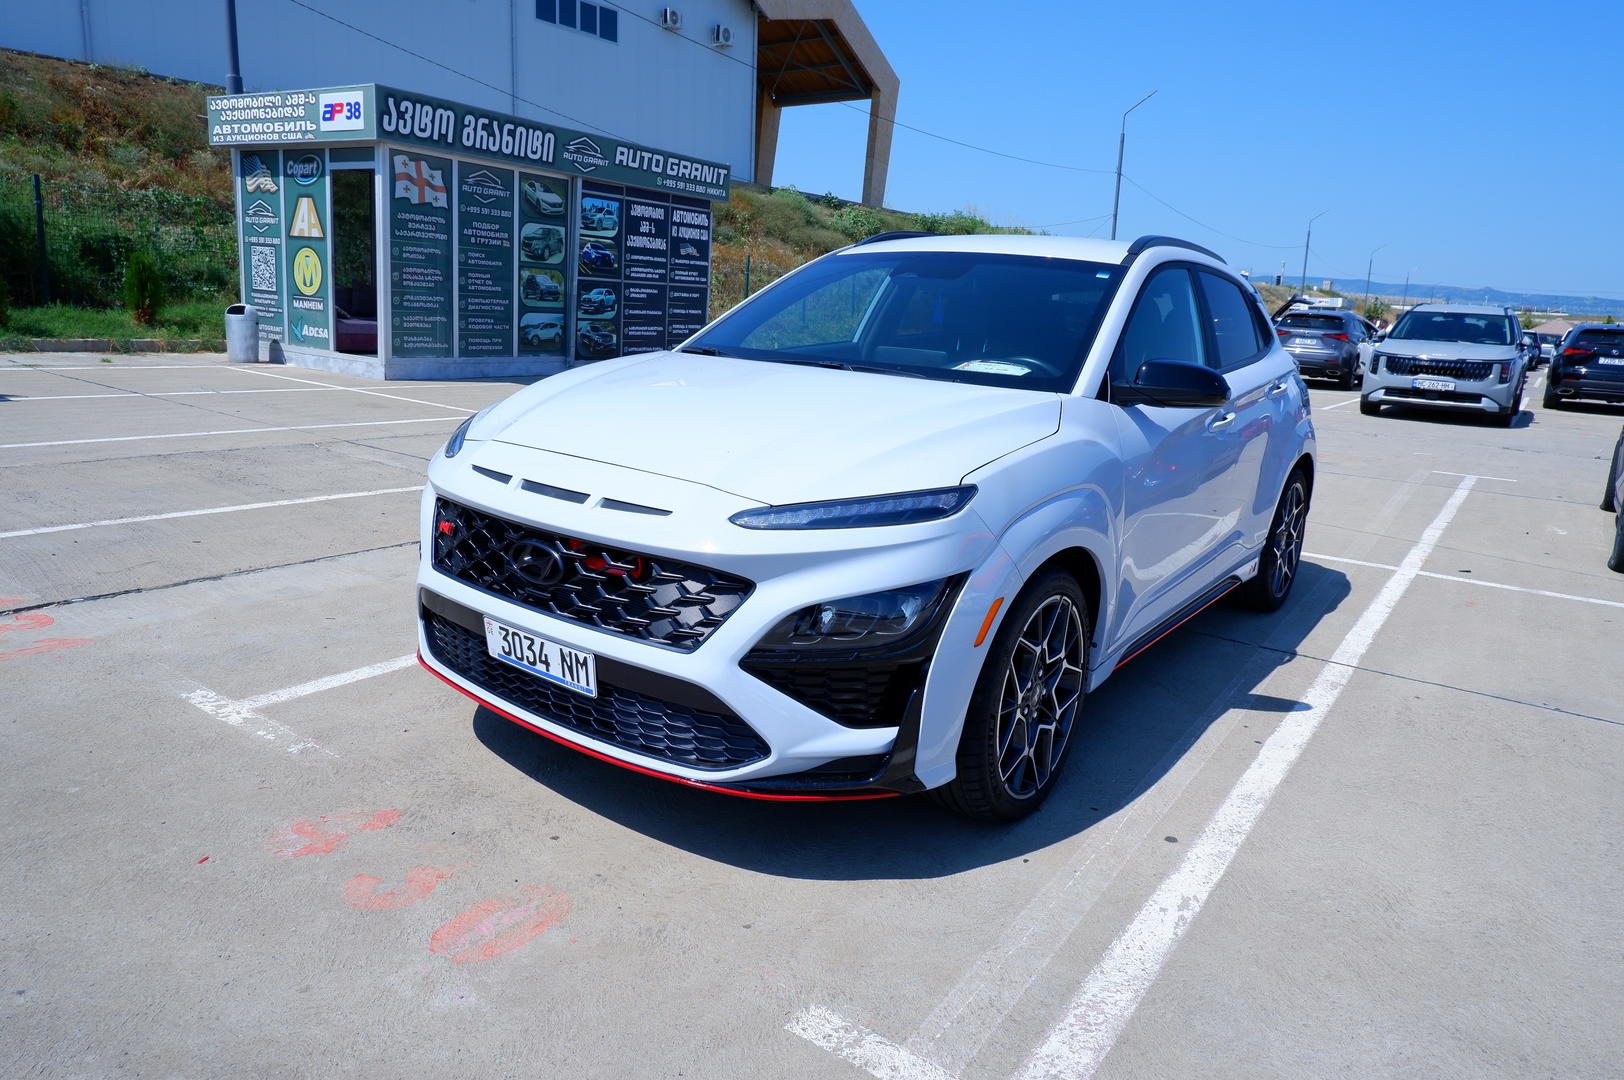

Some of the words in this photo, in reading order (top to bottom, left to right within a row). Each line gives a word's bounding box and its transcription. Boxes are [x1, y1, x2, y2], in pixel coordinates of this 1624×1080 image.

[210, 95, 282, 110] ავტომობილი
[285, 93, 316, 105] აშშ-ს
[213, 121, 317, 135] АВТОМОБИЛЬ
[382, 97, 455, 144] ავტო
[462, 114, 555, 163] გრანიტი
[227, 133, 279, 142] АУКЦИОНОВ
[281, 132, 303, 140] США
[563, 152, 583, 162] AUTO
[583, 156, 610, 167] GRANIT
[615, 146, 664, 173] AUTO
[666, 157, 728, 186] GRANIT
[287, 160, 318, 177] Copart
[462, 184, 483, 194] AUTO
[483, 187, 511, 198] GRANIT
[672, 209, 709, 227] АВТОМОБИЛЬ
[463, 228, 509, 239] АВТОМОБИЛЯ
[472, 221, 500, 231] ПОДБОР
[293, 300, 324, 311] MANHEIM
[302, 324, 329, 339] ADESA
[498, 625, 551, 673] 3034
[559, 647, 590, 687] NM
